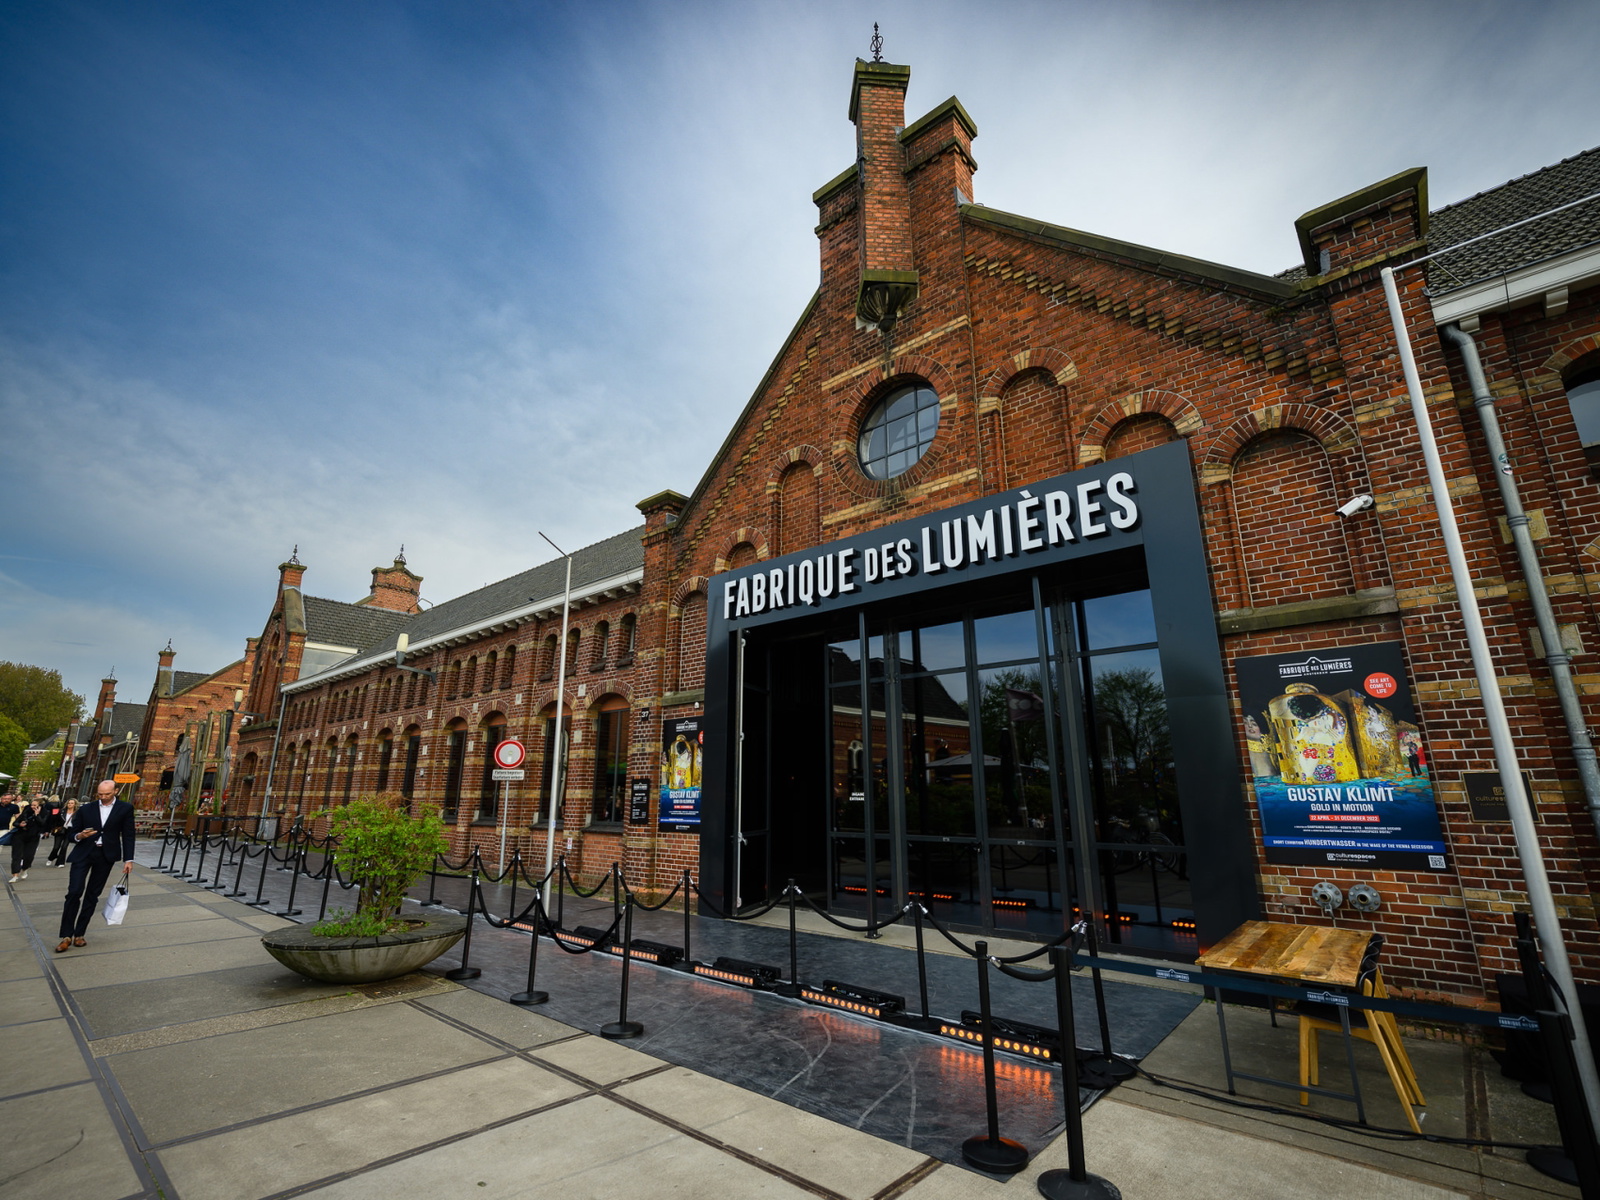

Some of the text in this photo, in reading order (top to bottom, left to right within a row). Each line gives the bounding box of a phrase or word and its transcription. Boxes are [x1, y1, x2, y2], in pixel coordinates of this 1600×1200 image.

[724, 472, 1138, 619] FABRIQUE DES LUMIÈRES
[1280, 666, 1310, 674] FABRIQUE
[1320, 662, 1352, 671] LUMIÈRES
[1288, 787, 1394, 802] GUSTAV KLIMT
